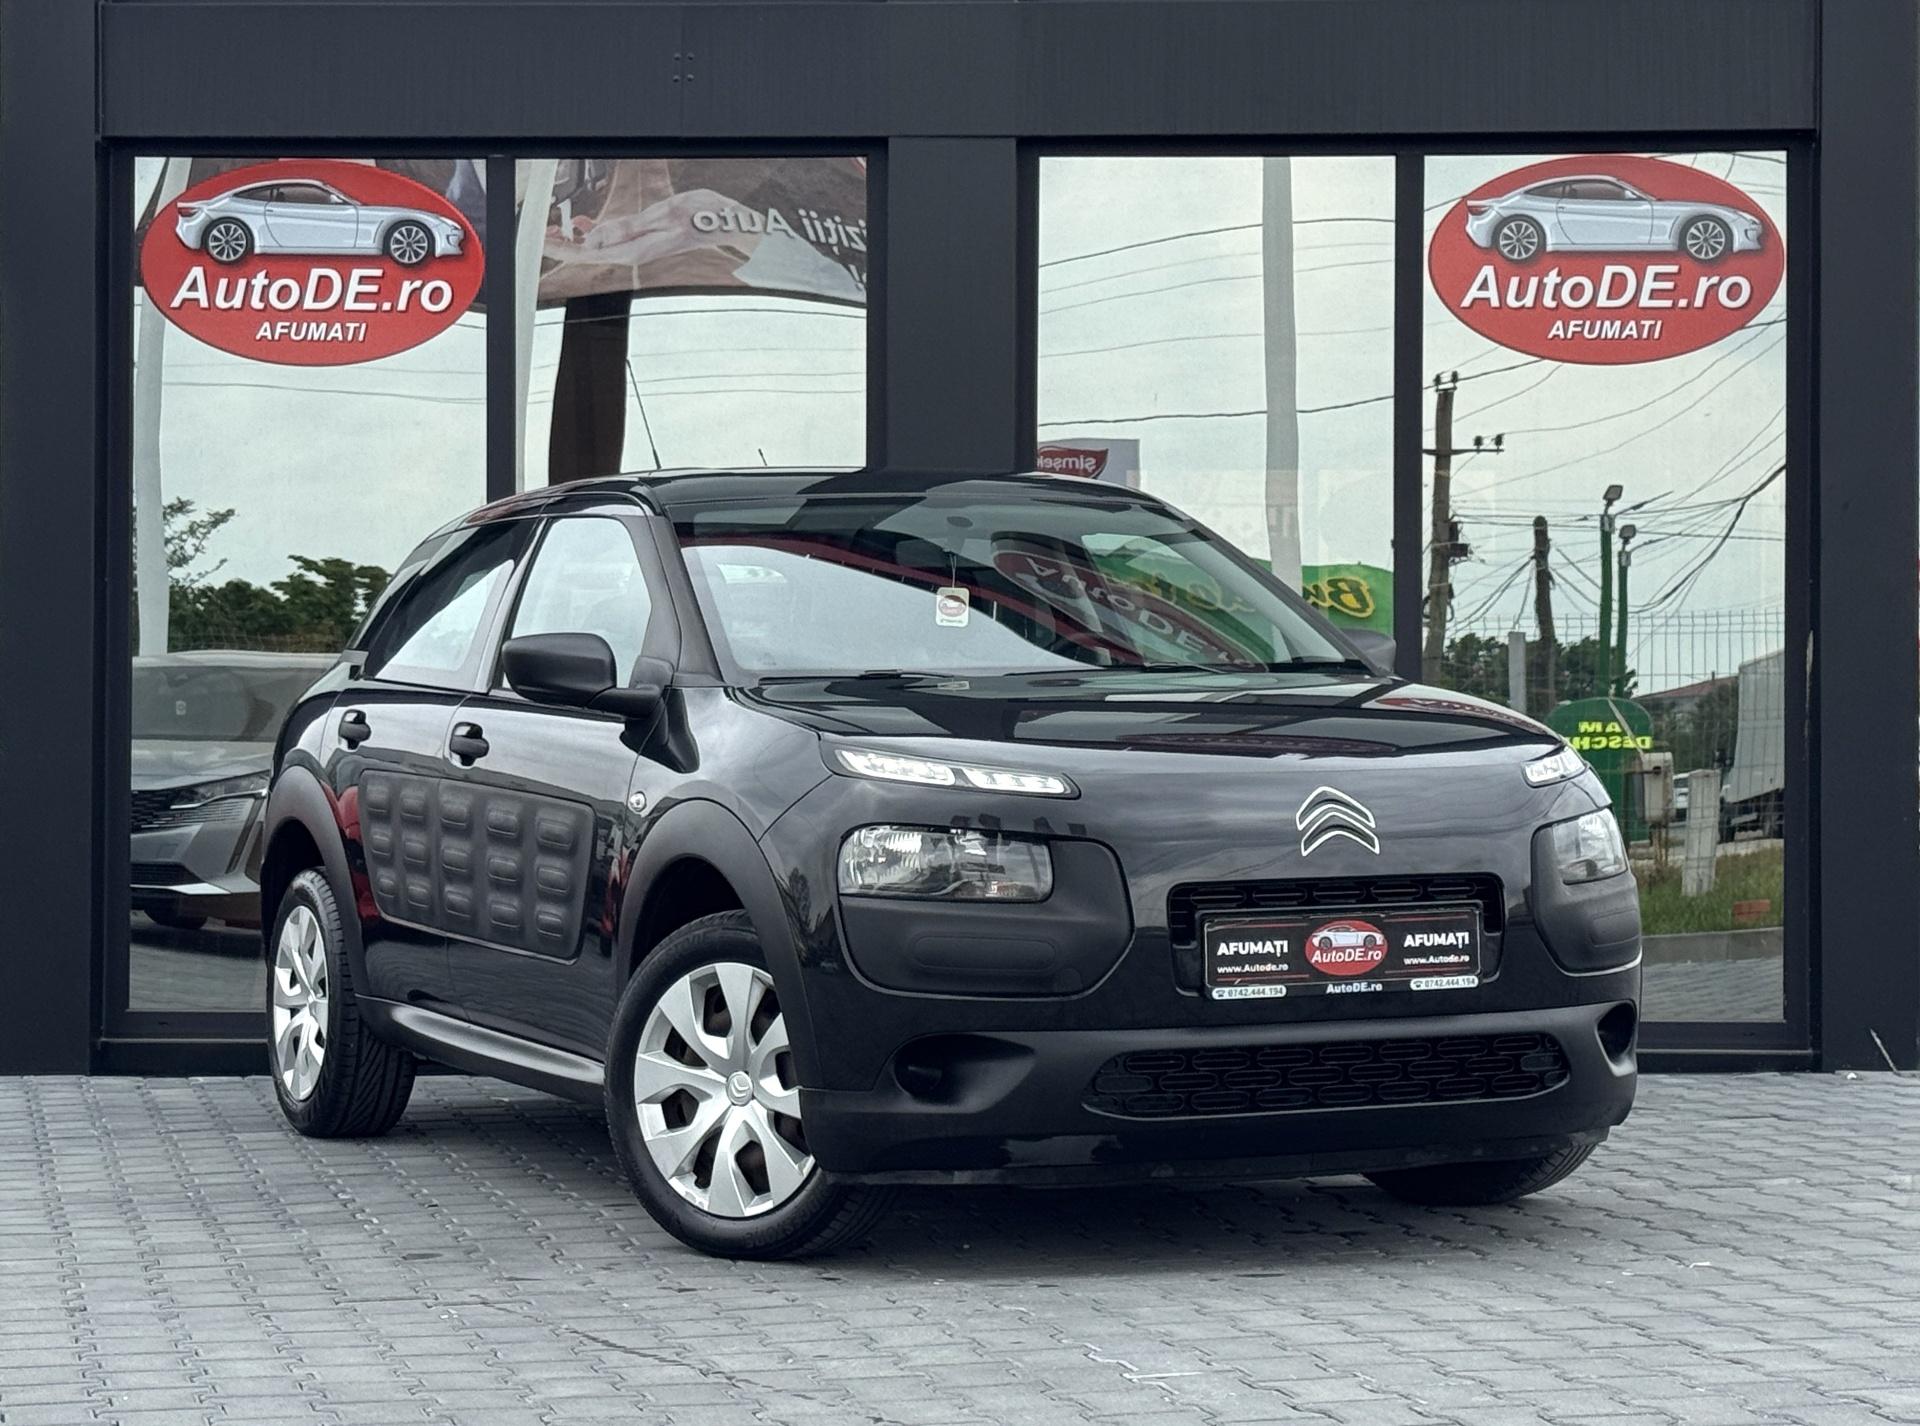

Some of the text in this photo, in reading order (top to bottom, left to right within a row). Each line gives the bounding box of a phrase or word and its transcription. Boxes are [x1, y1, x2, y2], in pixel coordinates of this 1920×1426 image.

[169, 265, 454, 313] AutoDE.ro
[1460, 264, 1752, 310] AutoDE.ro
[255, 321, 368, 342] AFUMATI
[1547, 319, 1663, 340] AFUMATI
[1311, 948, 1383, 964] AutoDE.ro
[1217, 963, 1289, 974] www.Autode.ro
[1325, 982, 1383, 994] AutoDE.ro
